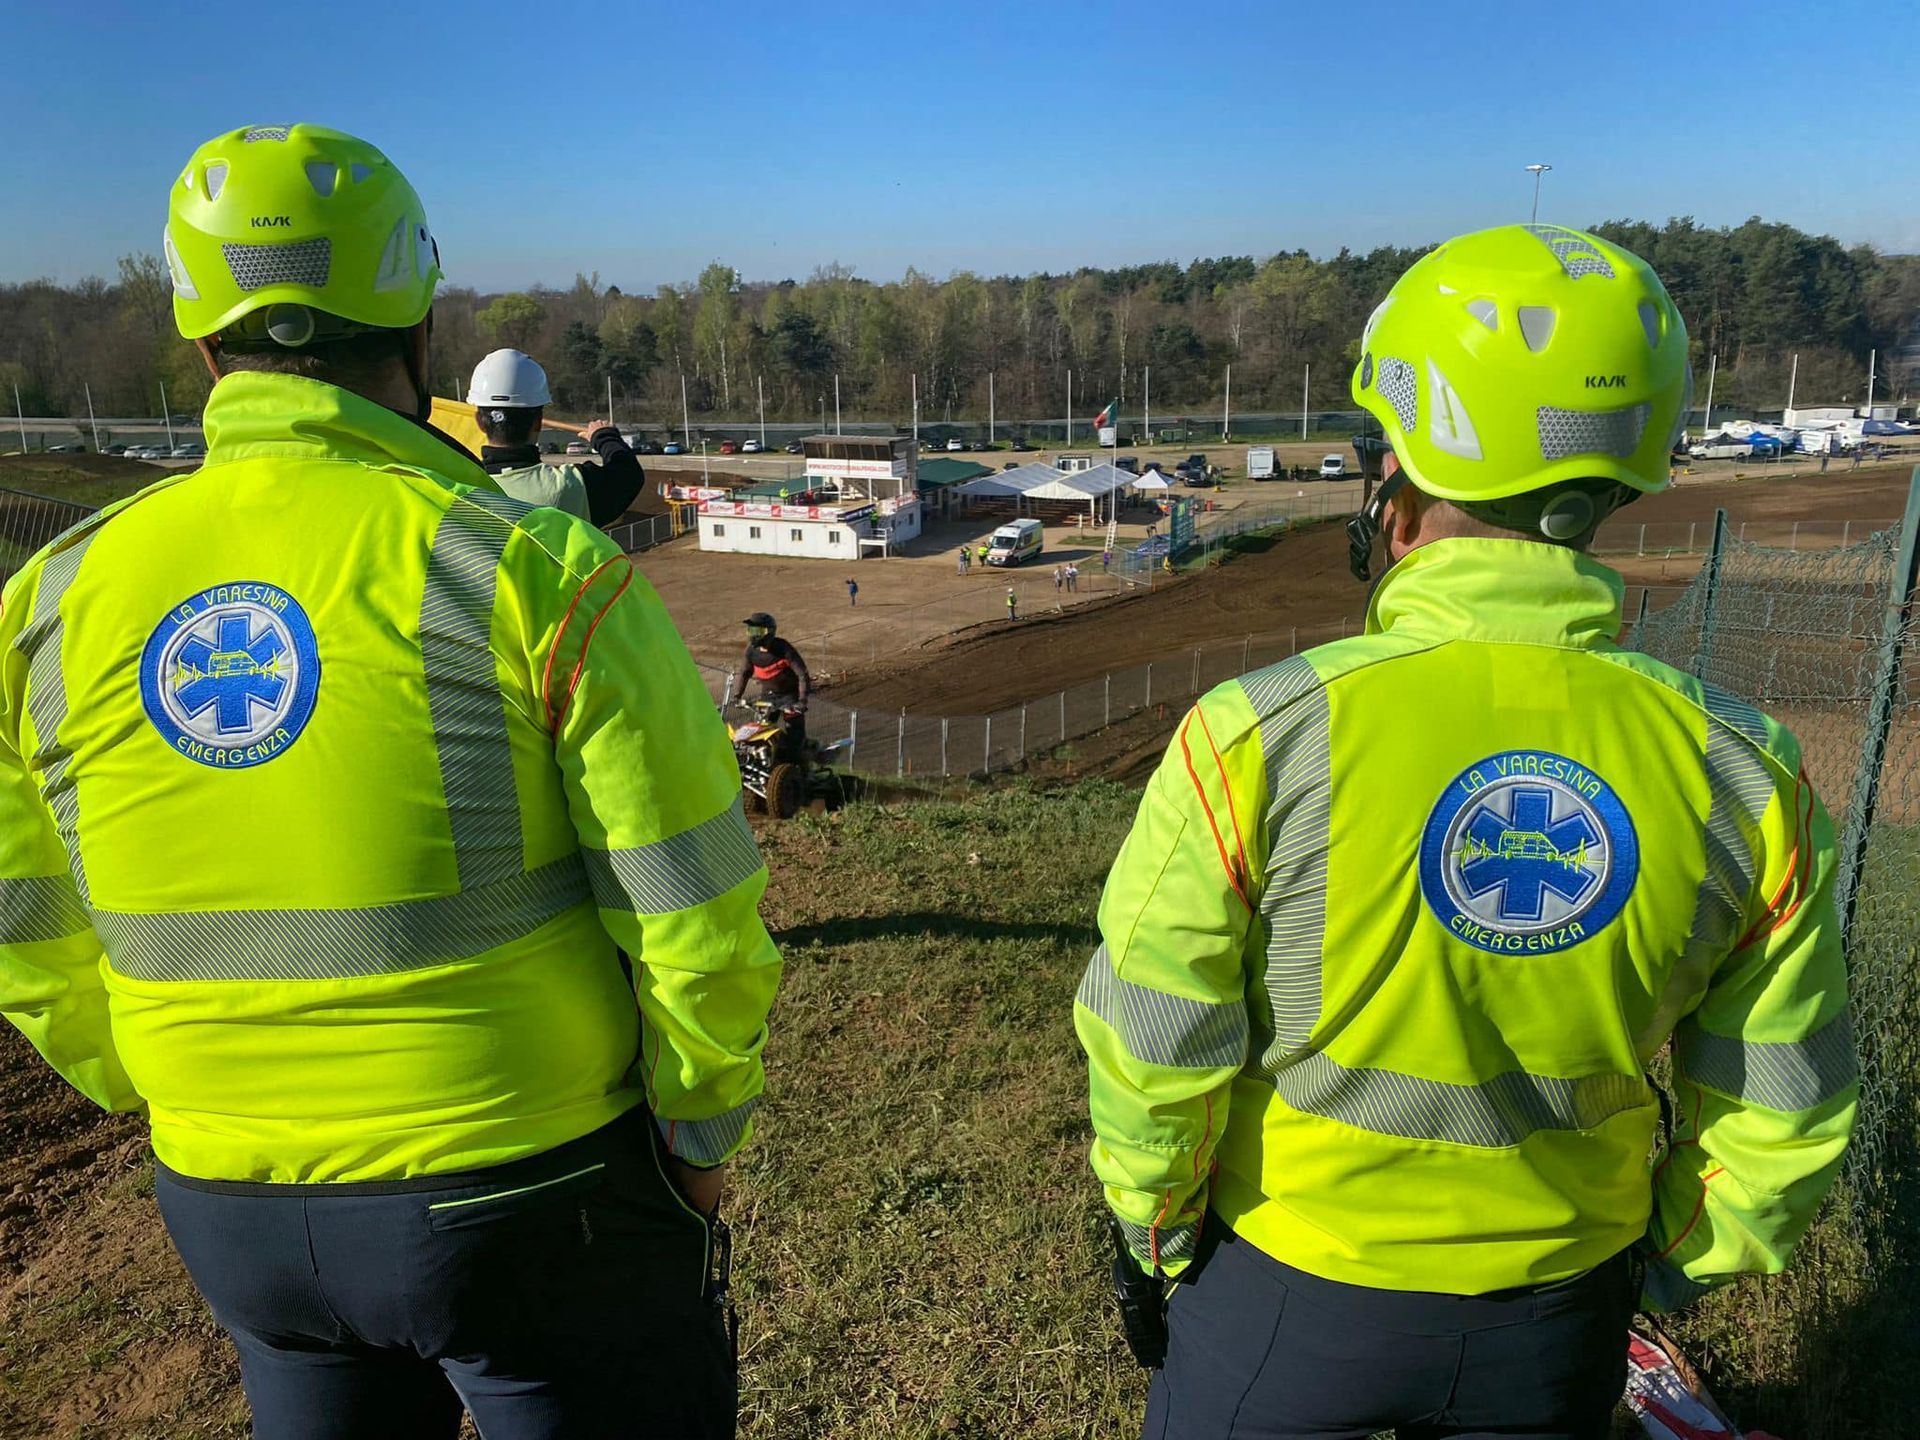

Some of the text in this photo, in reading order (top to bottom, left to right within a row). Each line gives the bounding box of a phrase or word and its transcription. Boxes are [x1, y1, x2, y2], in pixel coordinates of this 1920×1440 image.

[251, 216, 291, 228] KASK
[1585, 375, 1626, 388] KASK
[170, 585, 289, 625] LA VARESINA
[177, 728, 290, 764] EMERGENZA
[1459, 755, 1602, 800] LA VARESINA
[1450, 914, 1585, 950] EMERGENZA
